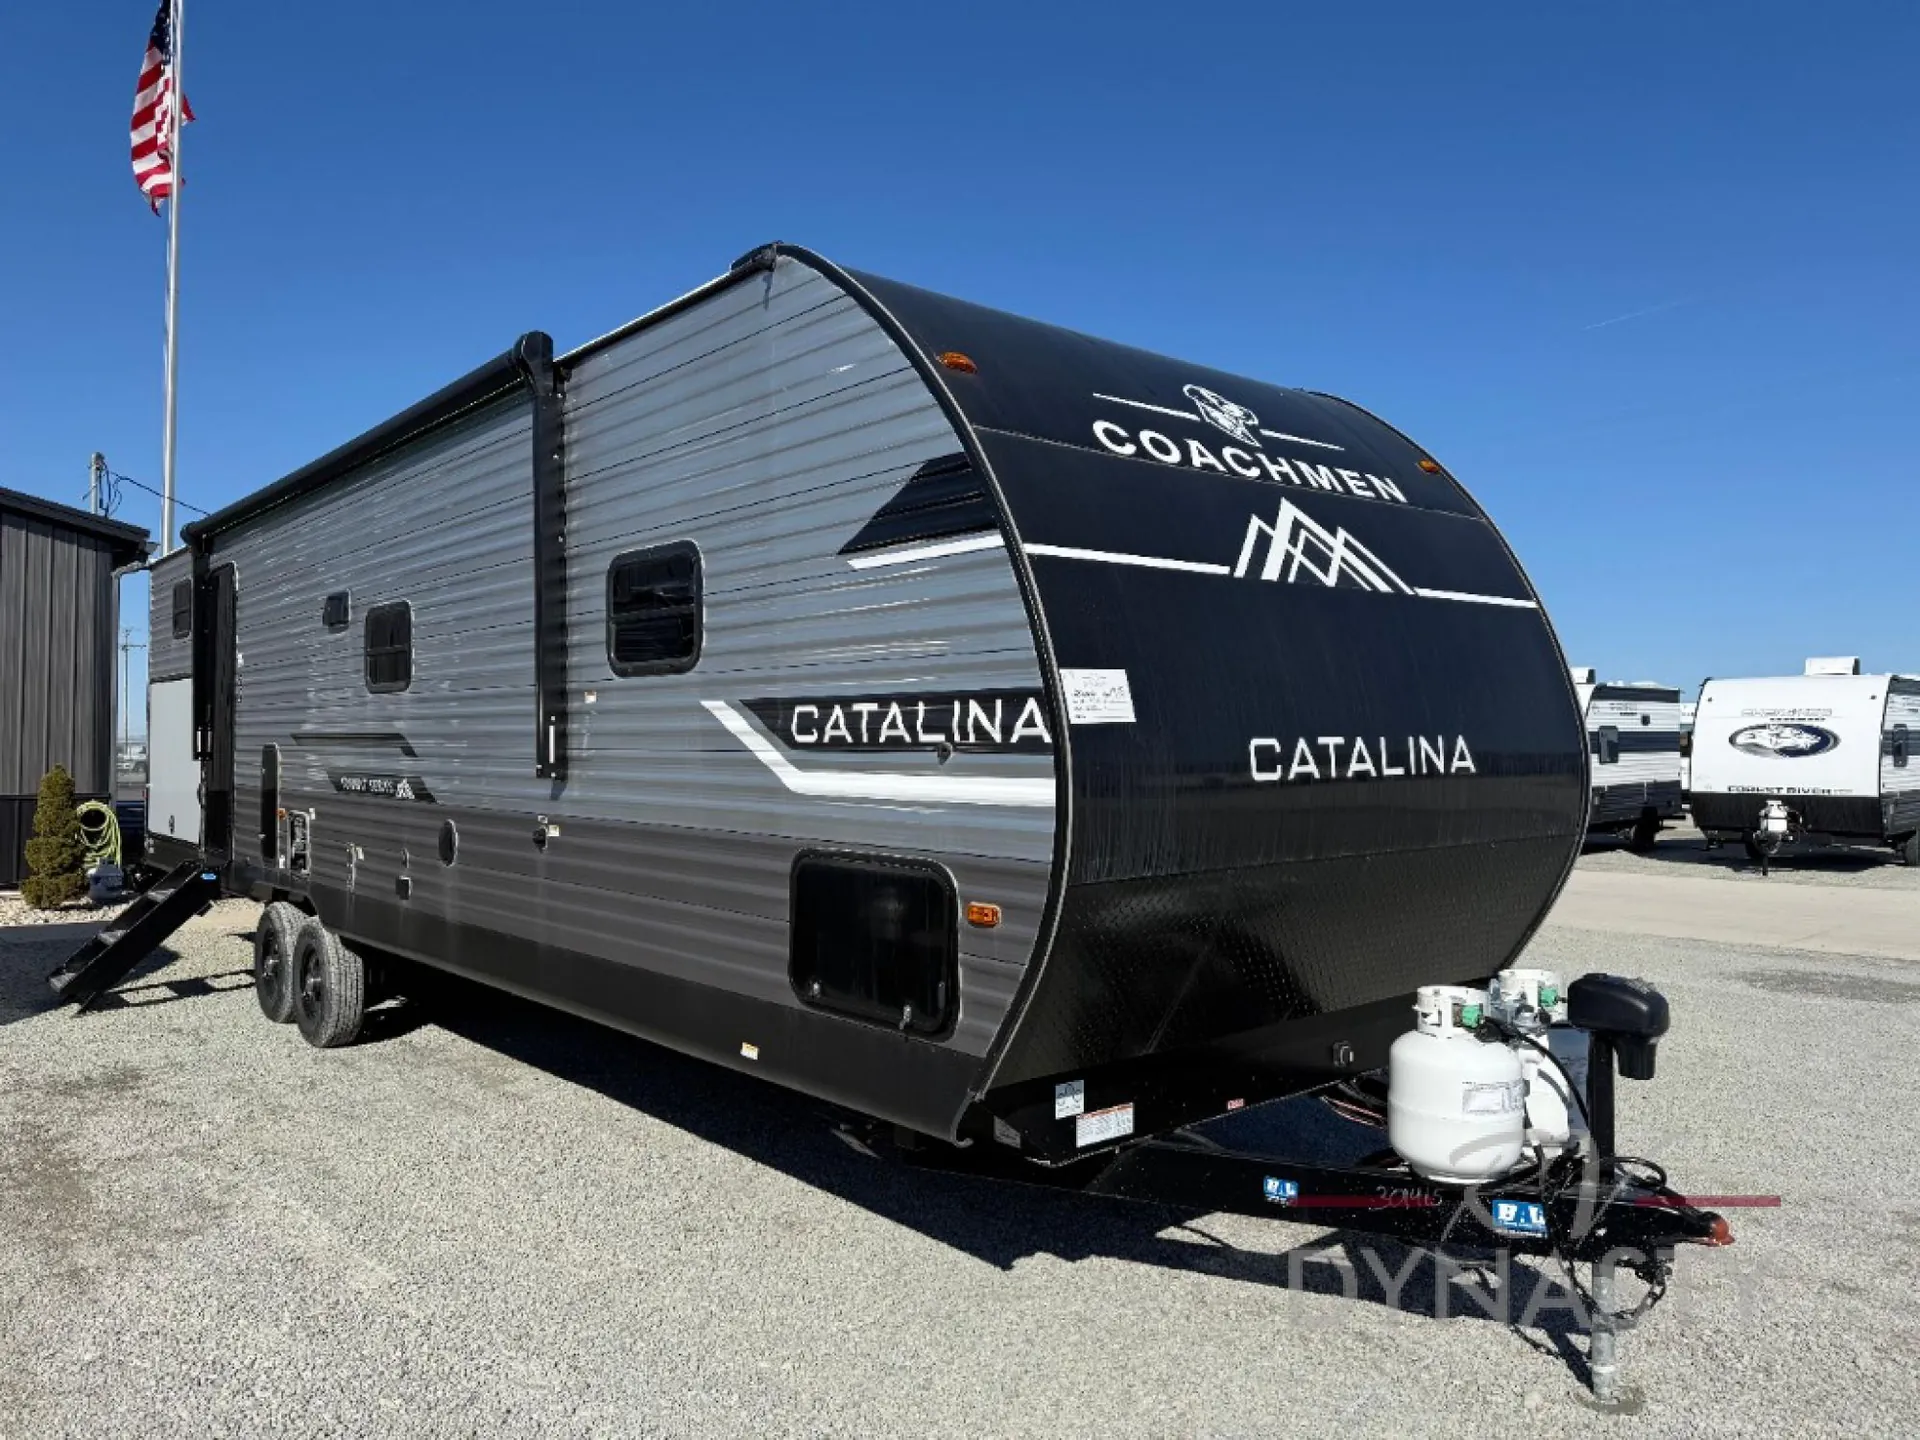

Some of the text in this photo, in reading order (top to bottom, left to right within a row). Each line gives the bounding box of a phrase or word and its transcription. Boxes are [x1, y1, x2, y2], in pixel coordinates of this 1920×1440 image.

[1093, 419, 1408, 503] COACHMEN
[791, 697, 1053, 744] CATALINA
[1249, 735, 1477, 782] CATALINA
